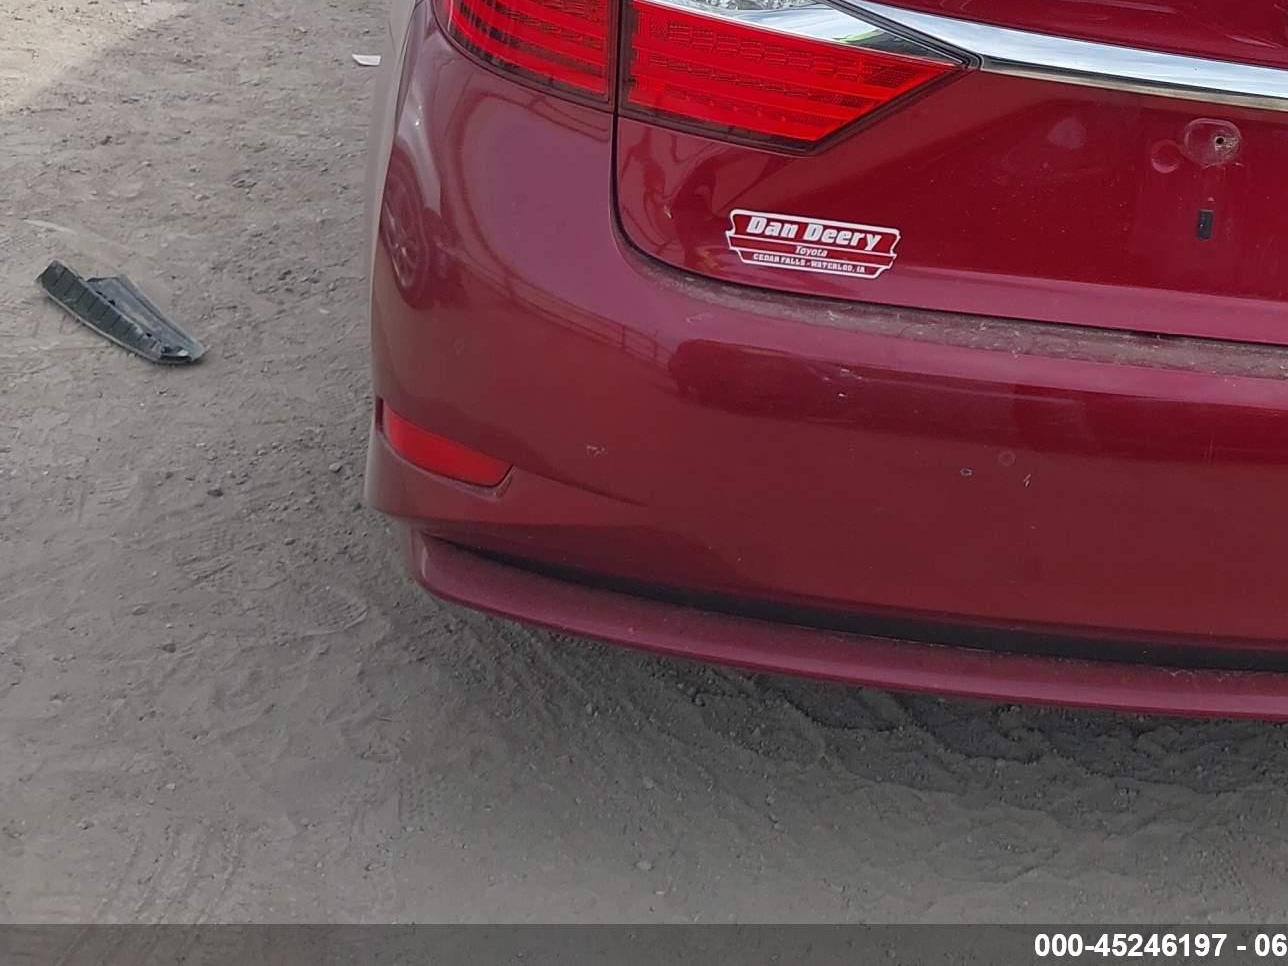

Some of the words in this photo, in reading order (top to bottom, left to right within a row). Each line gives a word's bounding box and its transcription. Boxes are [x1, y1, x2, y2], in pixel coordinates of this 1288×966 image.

[746, 216, 799, 239] Dan
[803, 223, 882, 251] Deery
[795, 245, 828, 258] Toyota
[753, 253, 780, 263] CEDAR
[780, 256, 806, 266] FALLS
